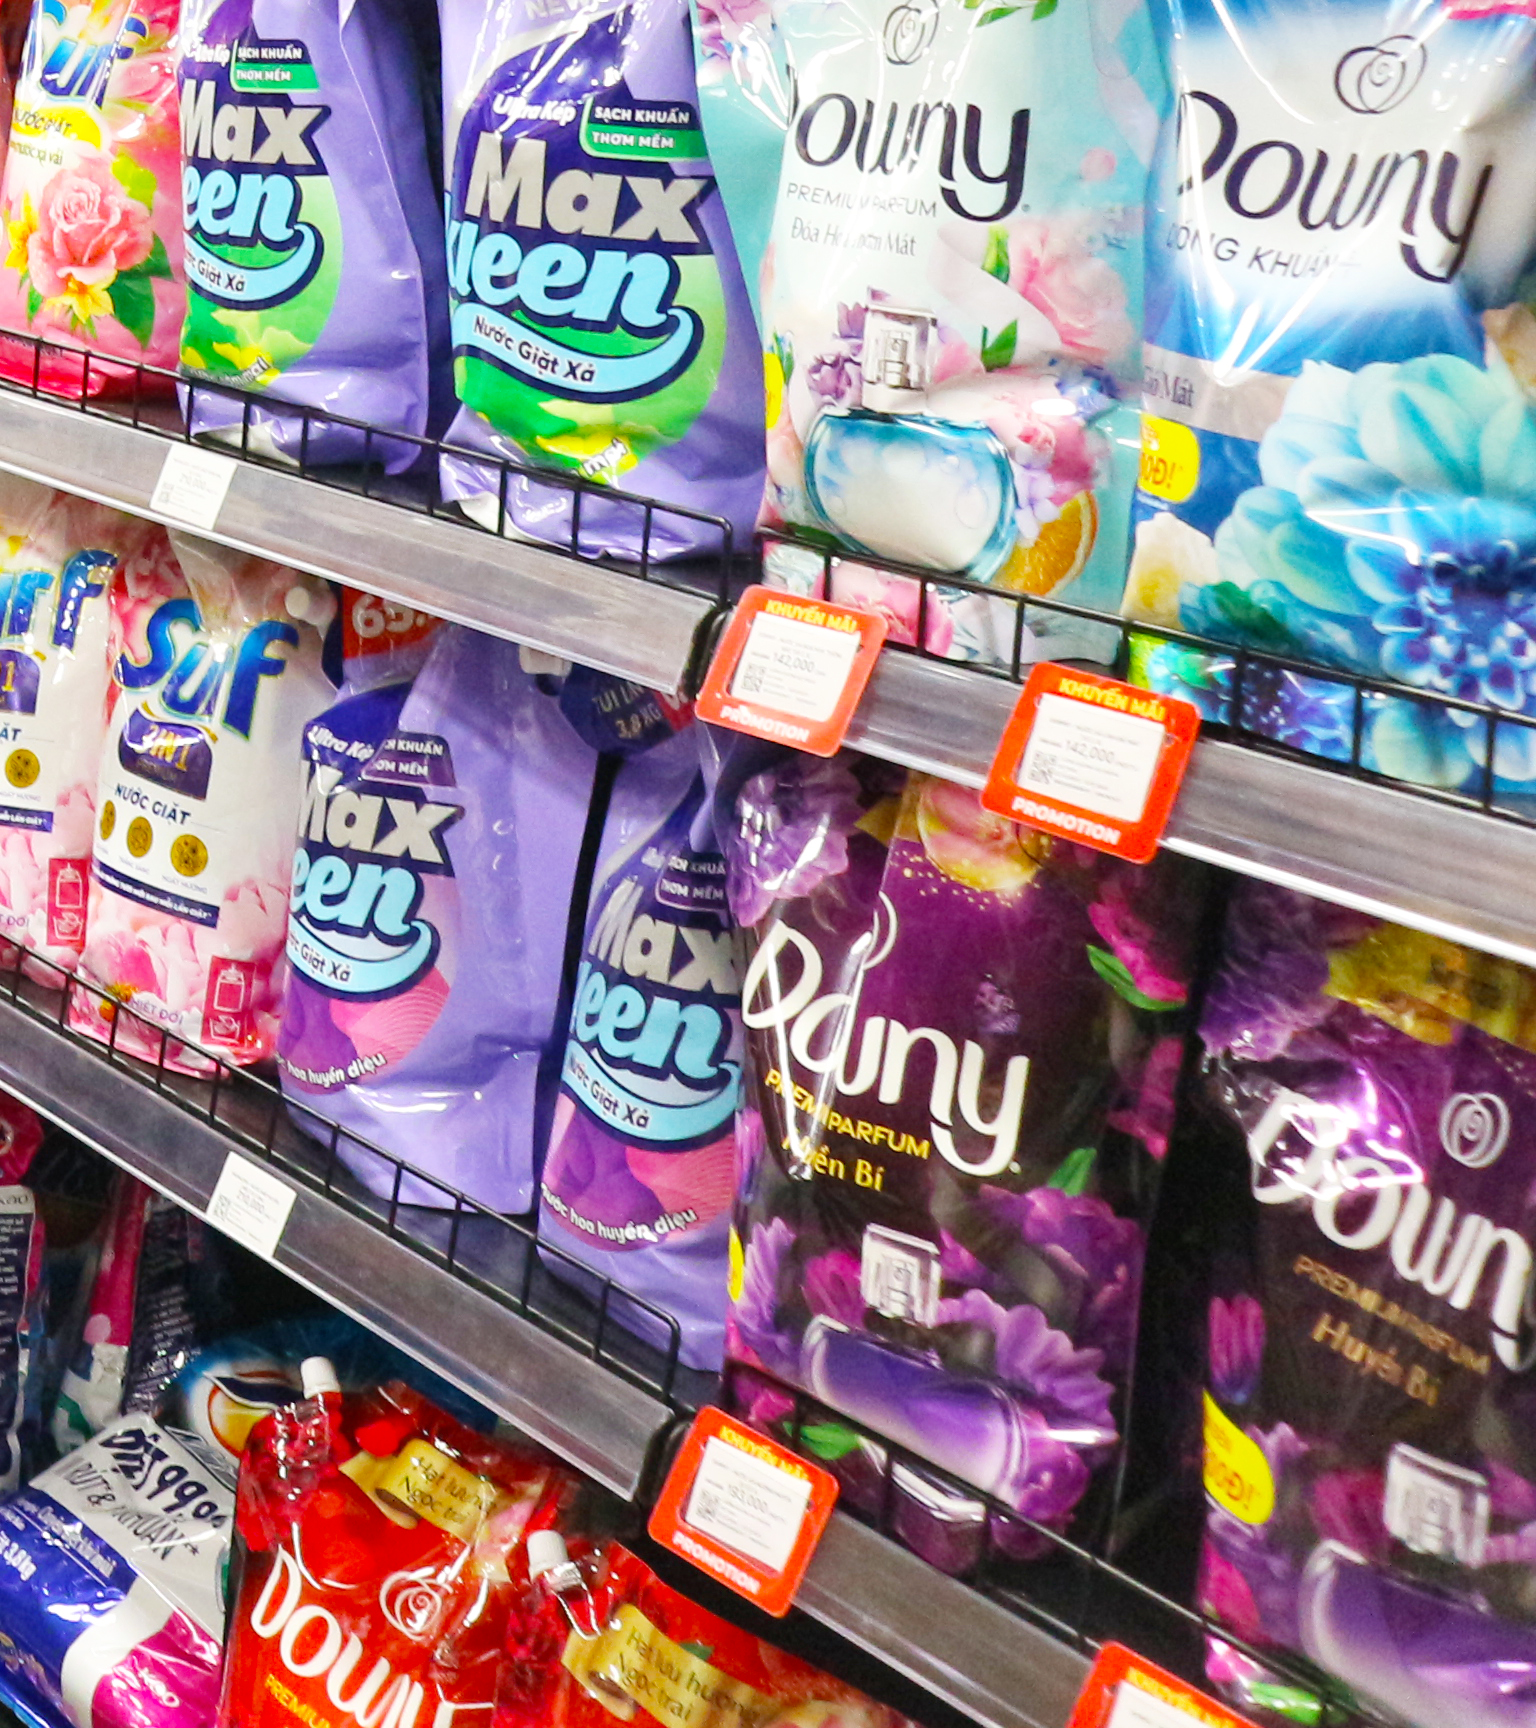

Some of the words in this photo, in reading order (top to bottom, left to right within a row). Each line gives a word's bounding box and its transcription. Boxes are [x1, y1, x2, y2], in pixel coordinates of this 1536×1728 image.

[261, 42, 303, 61] KHUẨN
[263, 66, 292, 83] MỀM
[181, 76, 318, 167] Max
[541, 98, 577, 128] Kép
[593, 105, 634, 128] SẠCH
[635, 103, 691, 125] KHUẨN
[591, 129, 632, 150] THƠM
[632, 129, 676, 151] MỀM
[786, 64, 1031, 222] owny
[182, 170, 299, 243] een
[465, 130, 709, 245] Max
[1176, 90, 1493, 284] Downy
[224, 272, 246, 293] Xả
[473, 314, 517, 355] Nước
[518, 341, 560, 378] Giặt
[562, 356, 597, 385] Xả
[764, 597, 823, 629] KHUYẾN
[824, 611, 858, 634] MÃI
[771, 651, 817, 673] 142,000
[1059, 676, 1128, 713] KHUYẾN
[1128, 695, 1166, 722] MÃI
[719, 704, 811, 743] PROMOTION
[398, 738, 445, 758] KHUẨN
[398, 758, 428, 776] MỀM
[1064, 739, 1118, 765] 142,000
[115, 782, 148, 809] NƯỚC
[151, 793, 192, 827] GIẶT
[297, 761, 458, 864] Max
[1011, 796, 1122, 845] PROMOTION
[289, 856, 419, 935] een
[300, 941, 327, 974] Giặt
[328, 960, 353, 985] Xả
[346, 1050, 388, 1084] diệu
[588, 1083, 619, 1118] Giặt
[621, 1102, 649, 1129] Xả
[829, 1109, 930, 1161] PARFUM
[854, 1155, 884, 1193] Bí
[569, 1207, 596, 1235] hoa
[653, 1207, 697, 1239] diệu
[1249, 1085, 1536, 1368] Down
[673, 1531, 762, 1594] PROMOTION
